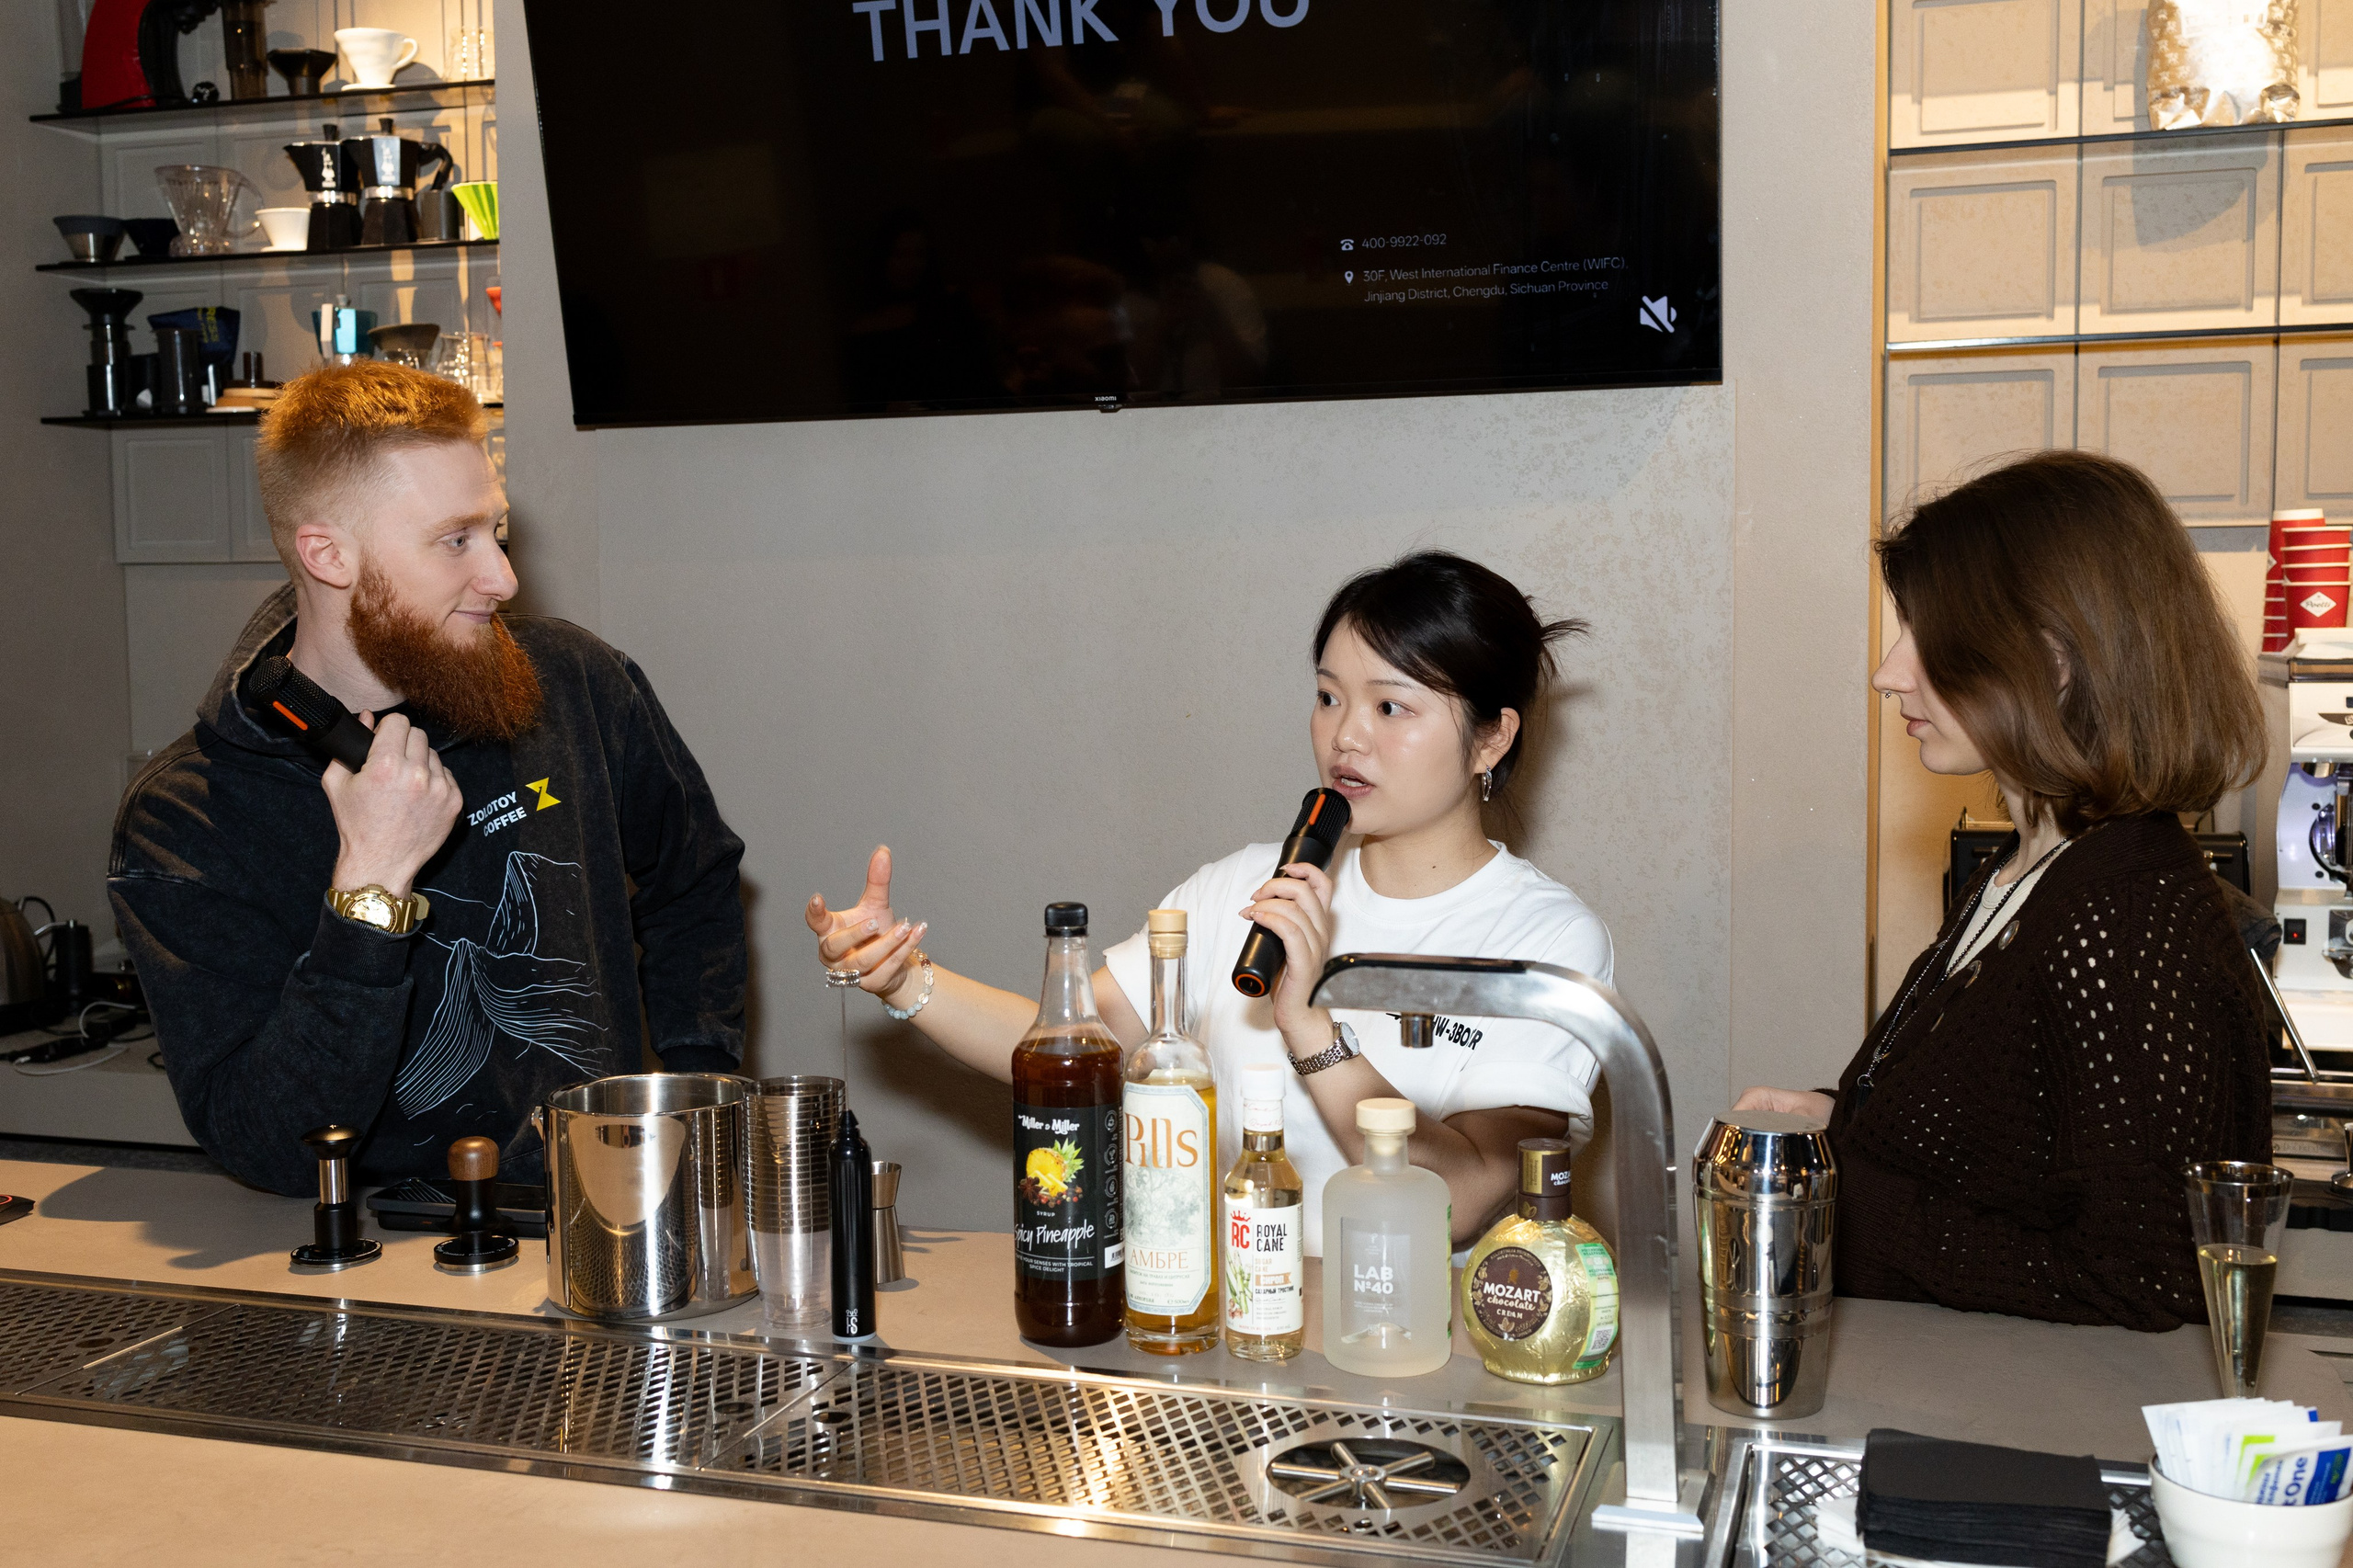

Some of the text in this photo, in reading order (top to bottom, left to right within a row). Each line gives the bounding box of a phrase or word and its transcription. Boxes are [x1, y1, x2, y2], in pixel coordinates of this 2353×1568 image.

[853, 0, 1120, 62] THANK
[1362, 233, 1447, 249] 400-9922-092
[1363, 269, 1388, 282] 30F,
[1390, 268, 1419, 280] West
[1421, 264, 1490, 278] International
[1493, 263, 1538, 275] Finance
[1540, 260, 1580, 272] Centre
[1364, 279, 1608, 304] Jinjiang District, Chengdu, Sichuan Province
[466, 790, 517, 826] ZOLOTOY
[483, 806, 528, 837] COFFEE
[1017, 1114, 1044, 1131] Miller
[1051, 1118, 1081, 1135] Miller
[1036, 1218, 1096, 1250] Pineapple
[1232, 1221, 1250, 1249] RC
[1256, 1223, 1288, 1238] ROYAL
[1256, 1238, 1284, 1252] CANE
[1029, 1264, 1042, 1272] SPICE
[1033, 1258, 1051, 1267] SENSES
[1130, 1248, 1188, 1269] АМБРЕ
[1354, 1264, 1393, 1280] LAB
[1483, 1282, 1541, 1303] MOZART
[1486, 1295, 1536, 1312] chocolate
[1496, 1308, 1524, 1320] CREAM
